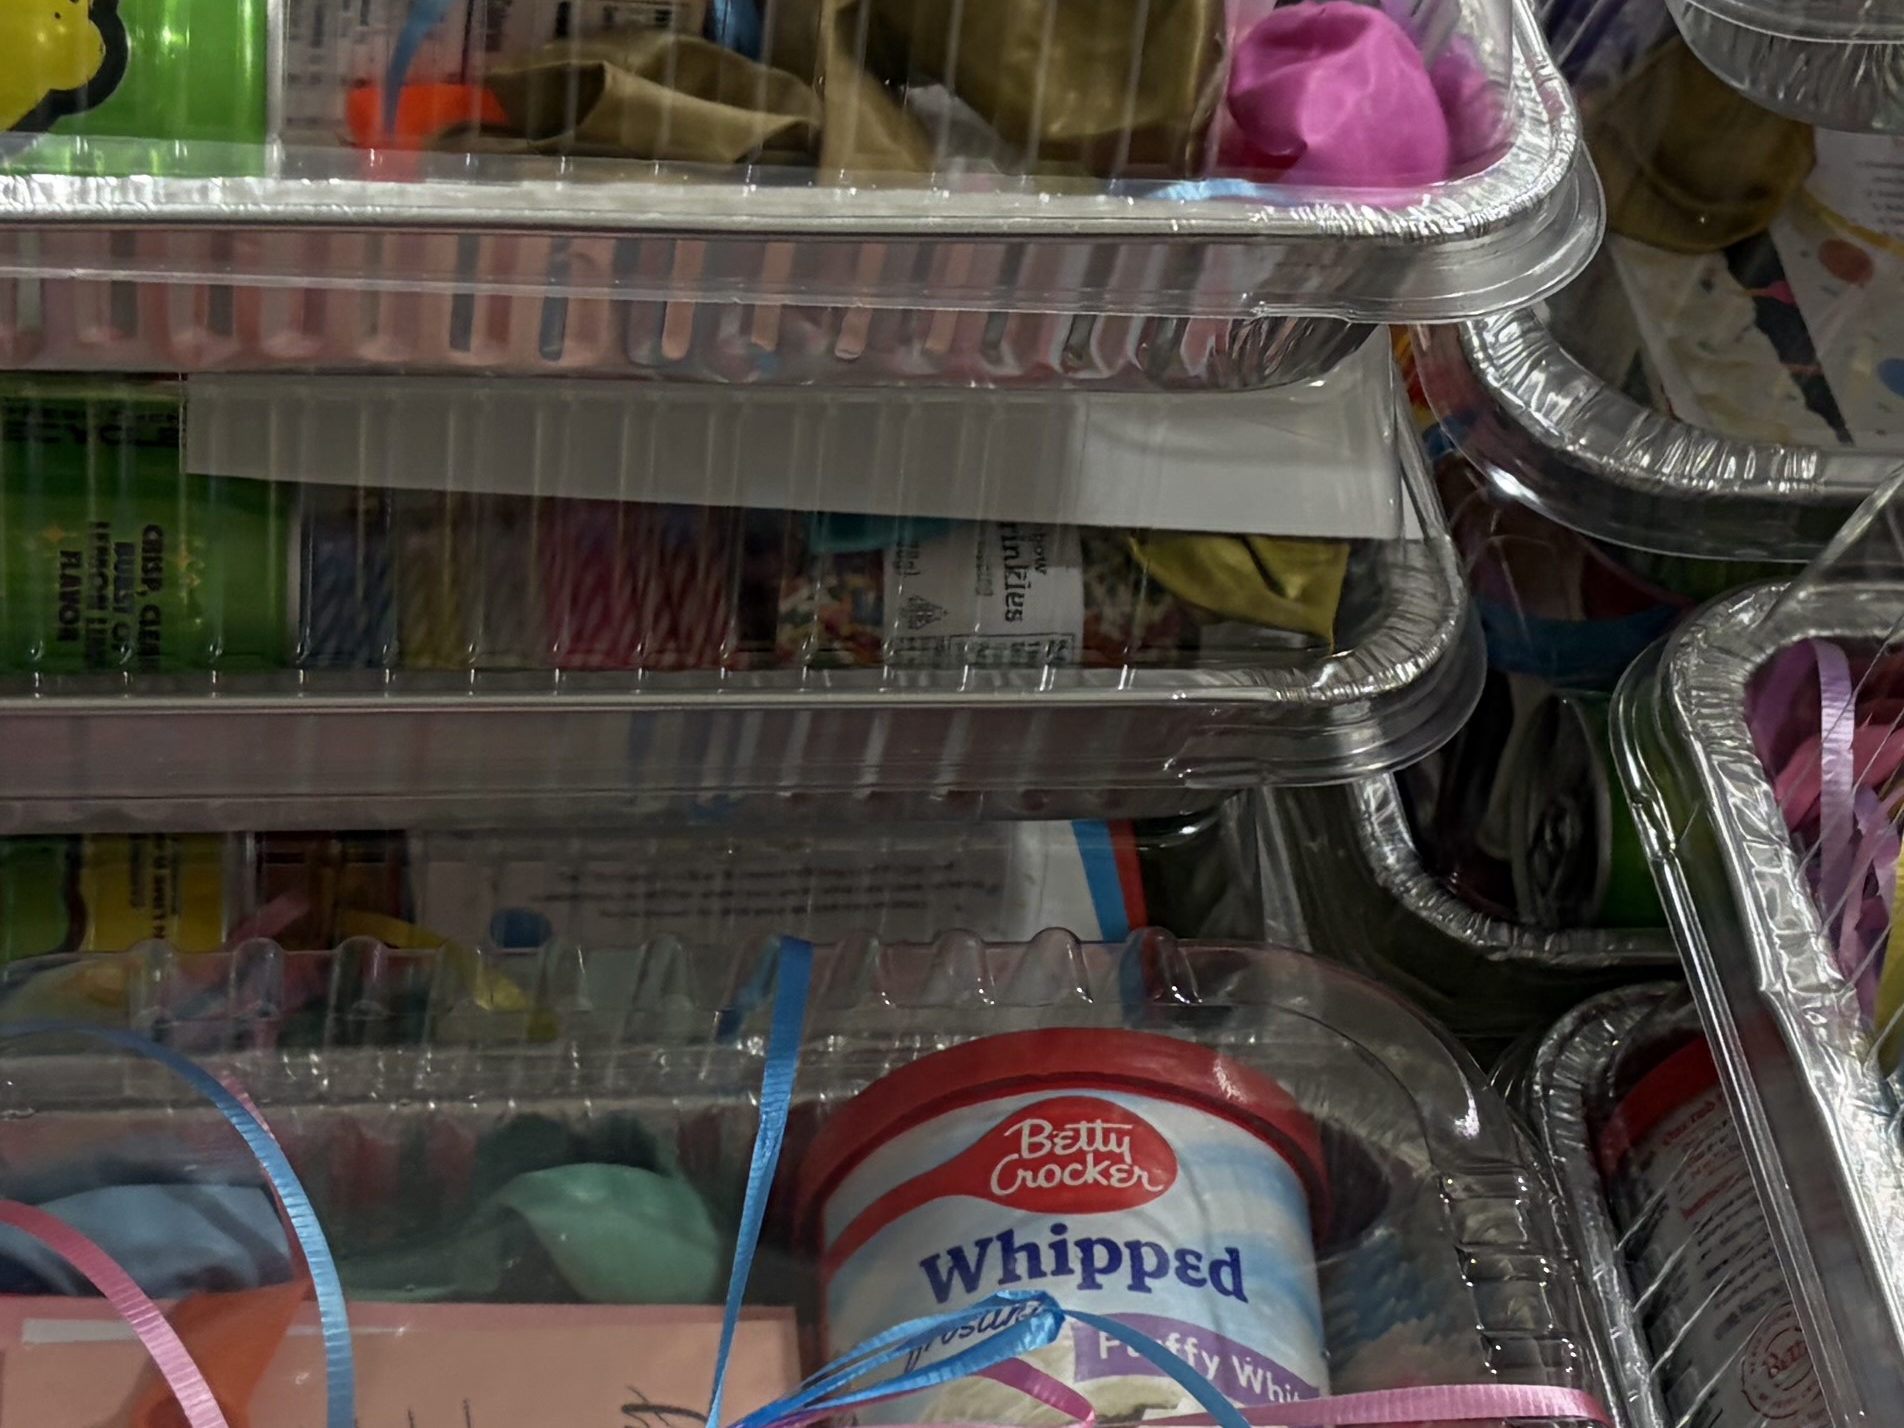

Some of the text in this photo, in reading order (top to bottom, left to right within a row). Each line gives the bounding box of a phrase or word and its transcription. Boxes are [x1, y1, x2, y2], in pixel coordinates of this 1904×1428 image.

[996, 522, 1034, 623] rinkles
[990, 1152, 1165, 1197] Crocker
[1004, 1119, 1133, 1167] Betty
[918, 1221, 1250, 1306] Whipped
[1099, 1331, 1302, 1404] Fffy Whi
